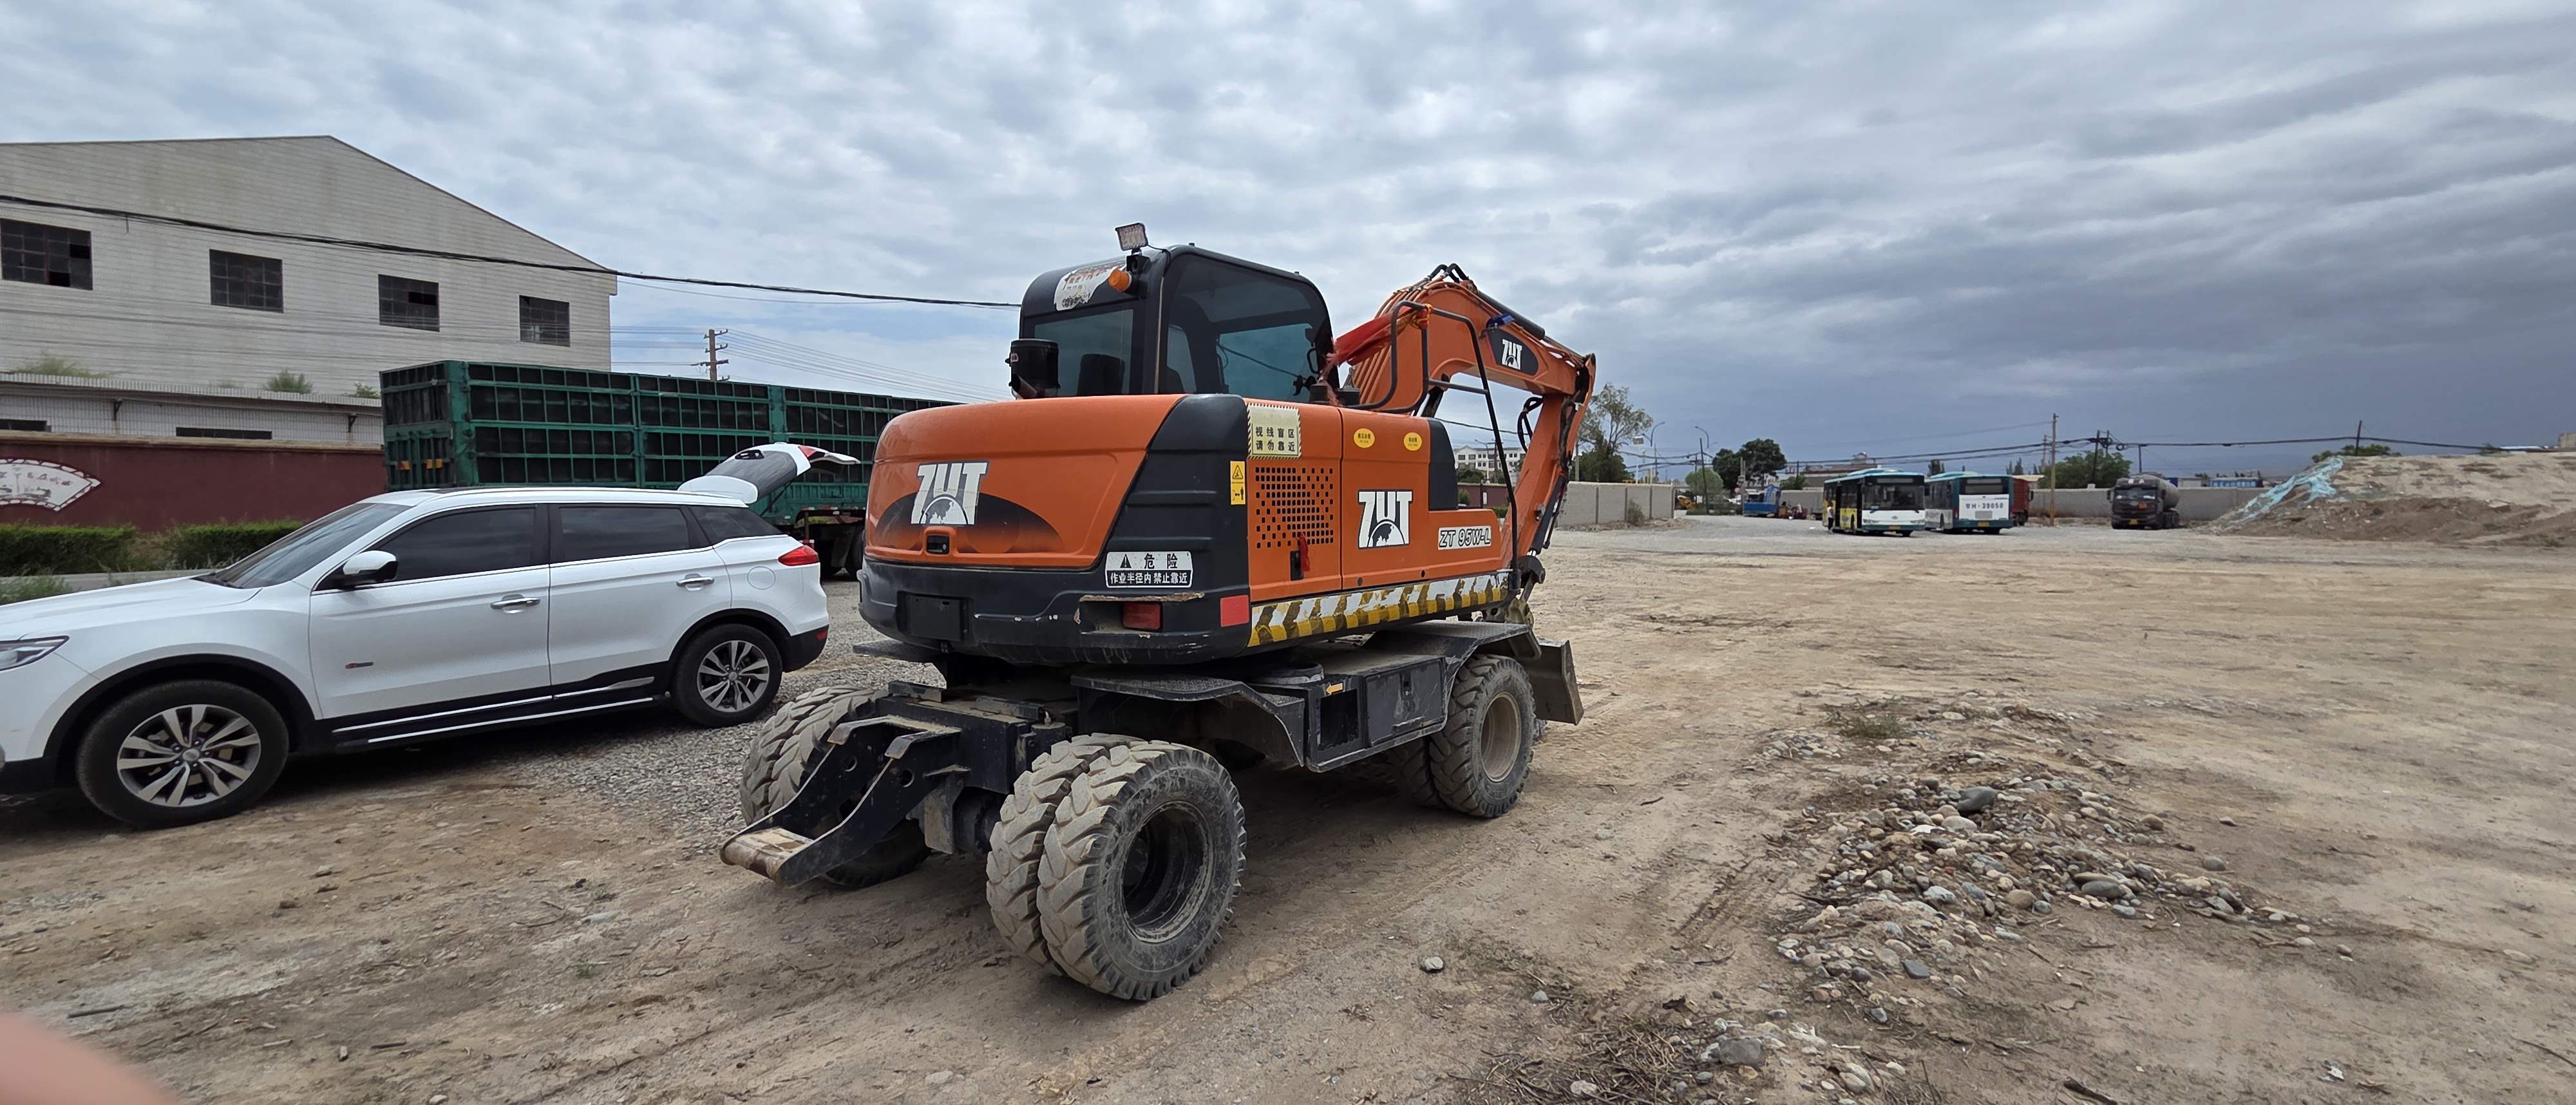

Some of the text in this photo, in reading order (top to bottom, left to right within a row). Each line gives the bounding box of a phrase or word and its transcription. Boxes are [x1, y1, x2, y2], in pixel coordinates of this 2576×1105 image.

[1255, 426, 1294, 438] 视线盲区
[1256, 439, 1295, 451] 请勿靠近
[1439, 528, 1491, 547] ZT 95W-L
[1144, 552, 1178, 569] 危险
[1110, 572, 1188, 584] 作业半径内 禁止靠近
